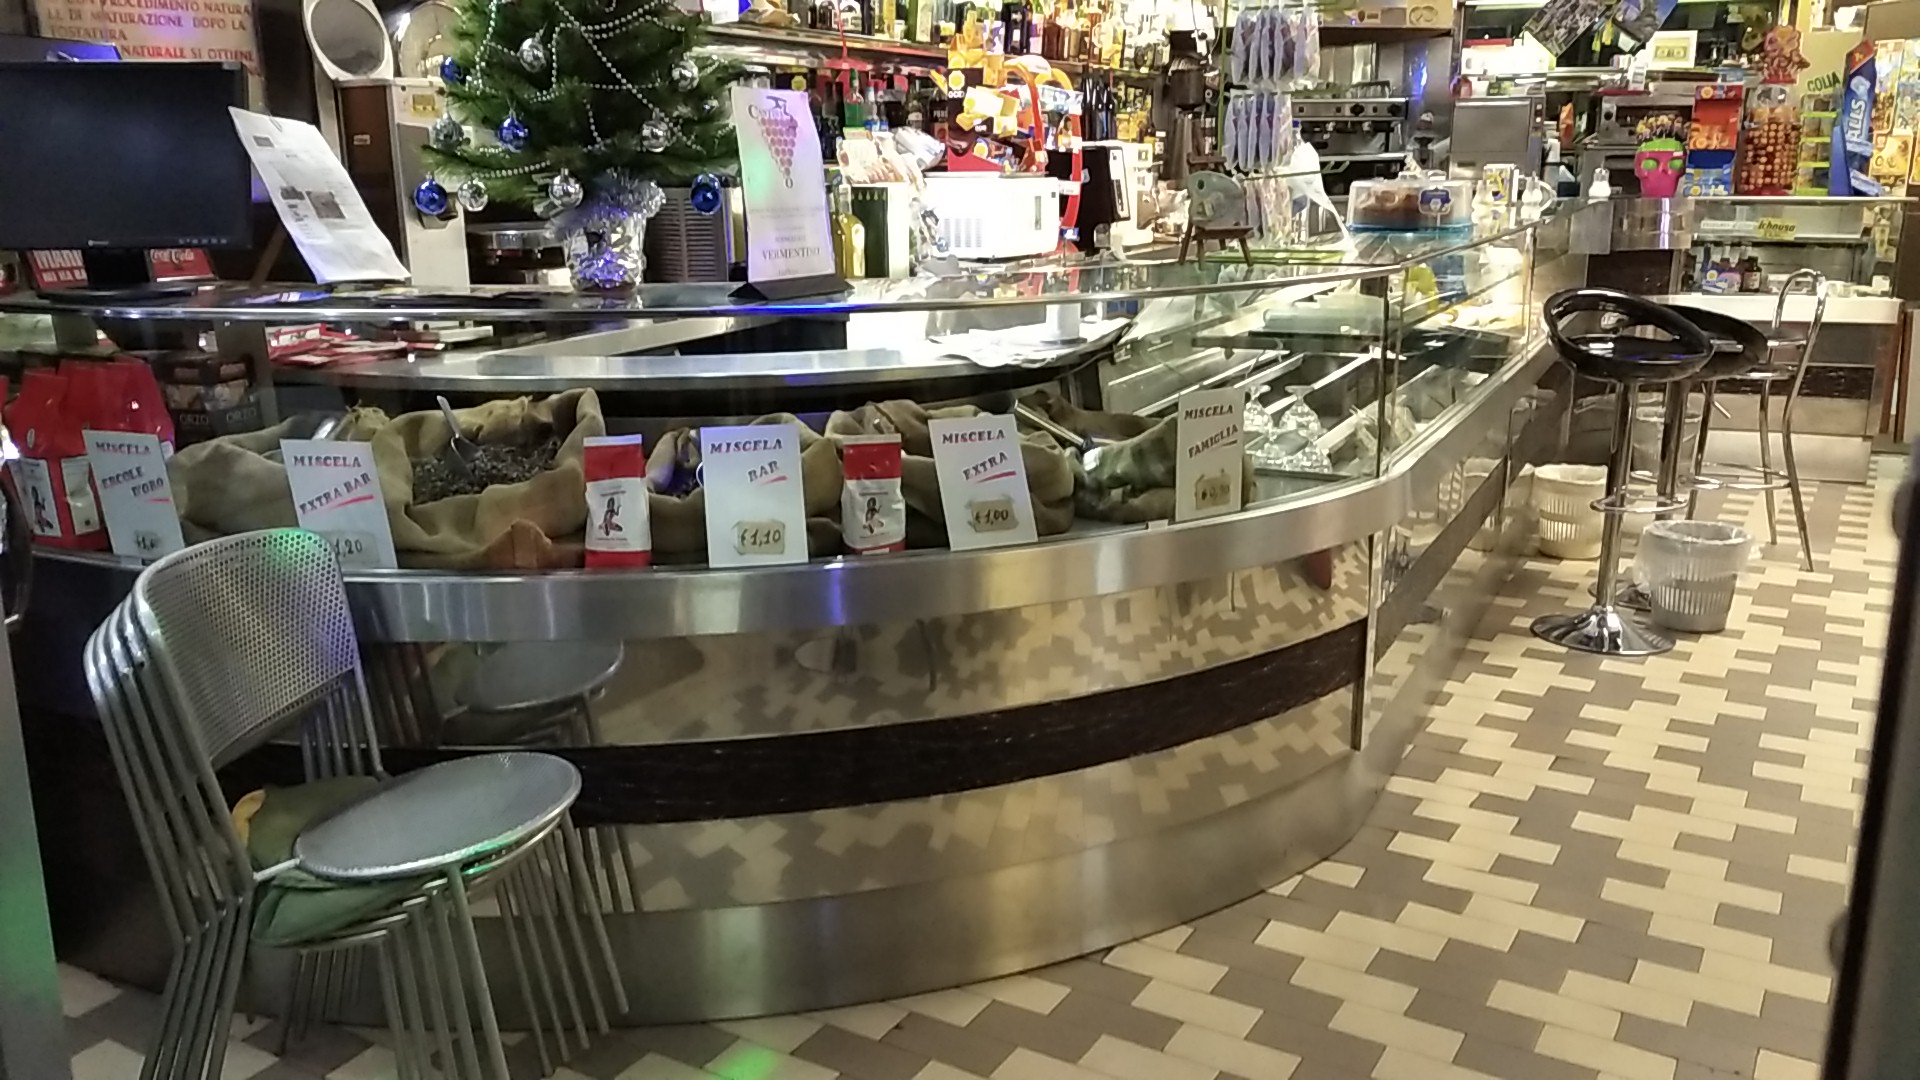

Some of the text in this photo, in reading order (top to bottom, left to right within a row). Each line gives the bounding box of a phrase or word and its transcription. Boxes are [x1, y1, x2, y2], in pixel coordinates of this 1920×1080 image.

[69, 9, 83, 22] DI
[192, 16, 226, 29] DOPO
[231, 18, 246, 31] LA
[191, 47, 203, 59] SI
[1846, 98, 1866, 141] ALLS
[1758, 219, 1797, 232] Ichnusa
[762, 246, 821, 260] VERMENTINO
[1184, 404, 1234, 420] MISCELA
[941, 428, 1006, 445] MISCELA
[1187, 424, 1239, 458] FAMIGLIA
[95, 440, 152, 456] MISCELA
[709, 438, 784, 455] MISCELA
[293, 454, 362, 469] MISCELA
[962, 451, 1010, 481] EXTRA
[101, 465, 144, 490] ERCOLE
[747, 460, 781, 483] BAR
[130, 476, 165, 497] D'ORO
[299, 471, 373, 516] EXTRA BAR
